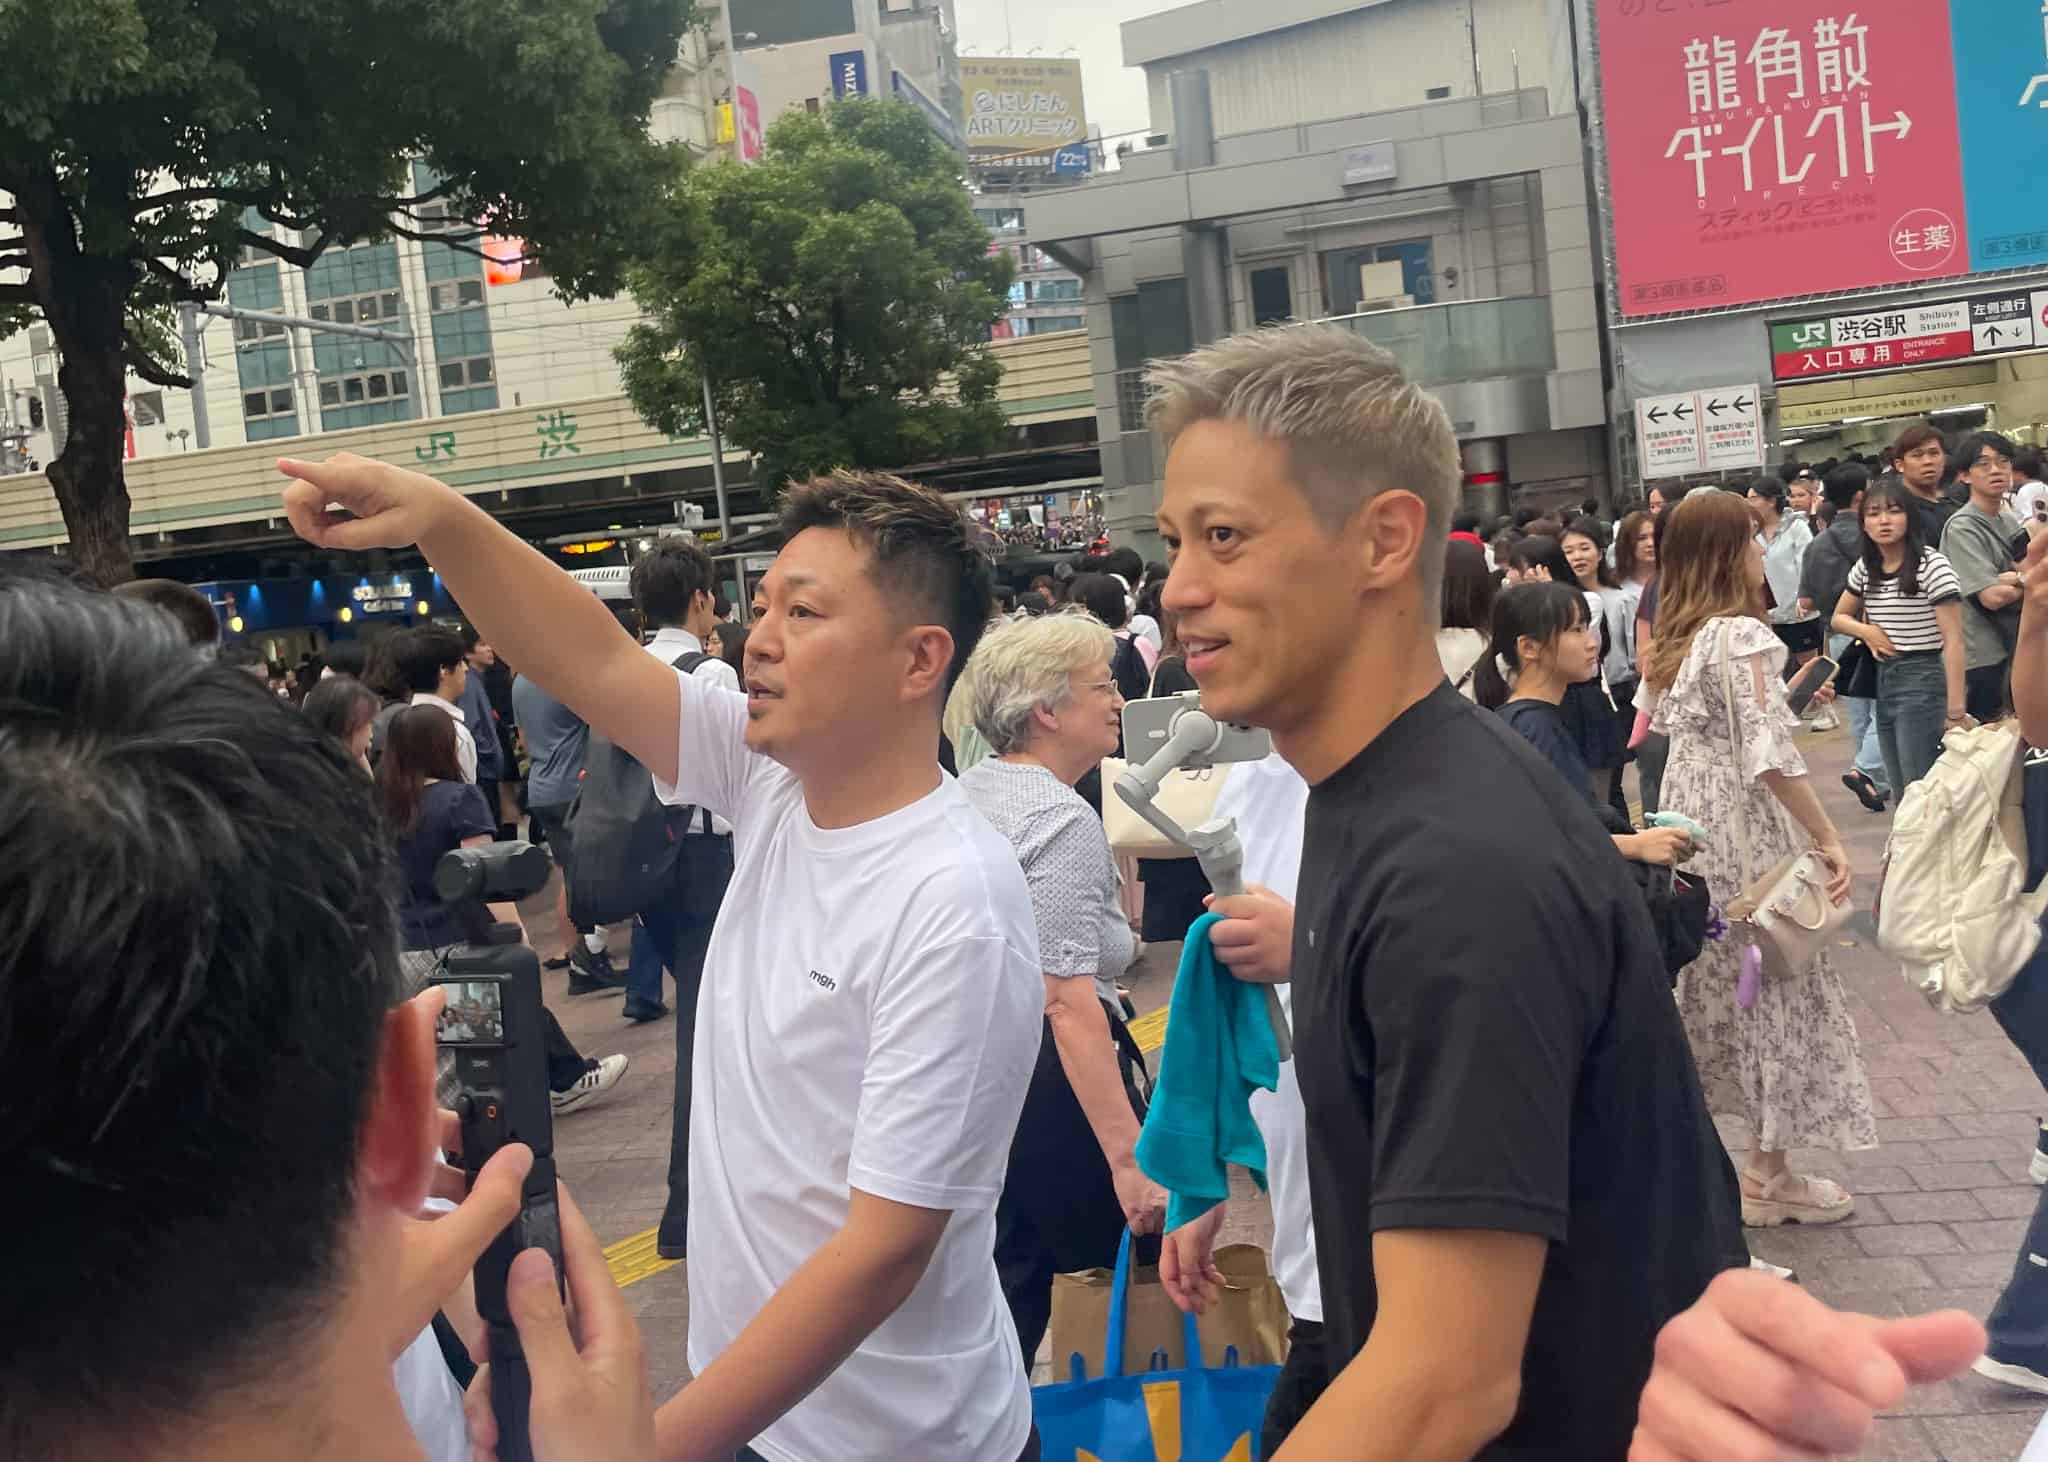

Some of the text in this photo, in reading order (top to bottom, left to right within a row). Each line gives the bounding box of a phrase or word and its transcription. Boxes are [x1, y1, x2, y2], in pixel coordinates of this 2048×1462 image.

[1683, 14, 1873, 115] 龍角散
[1895, 224, 1952, 255] 生薬
[1837, 314, 1907, 342] 渋谷駅
[1919, 308, 1960, 321] Shibuya
[1919, 320, 1957, 332] Station
[1792, 323, 1826, 343] JR
[1802, 344, 1890, 371] 入口専用
[415, 432, 456, 461] JR
[809, 970, 837, 991] mgh
